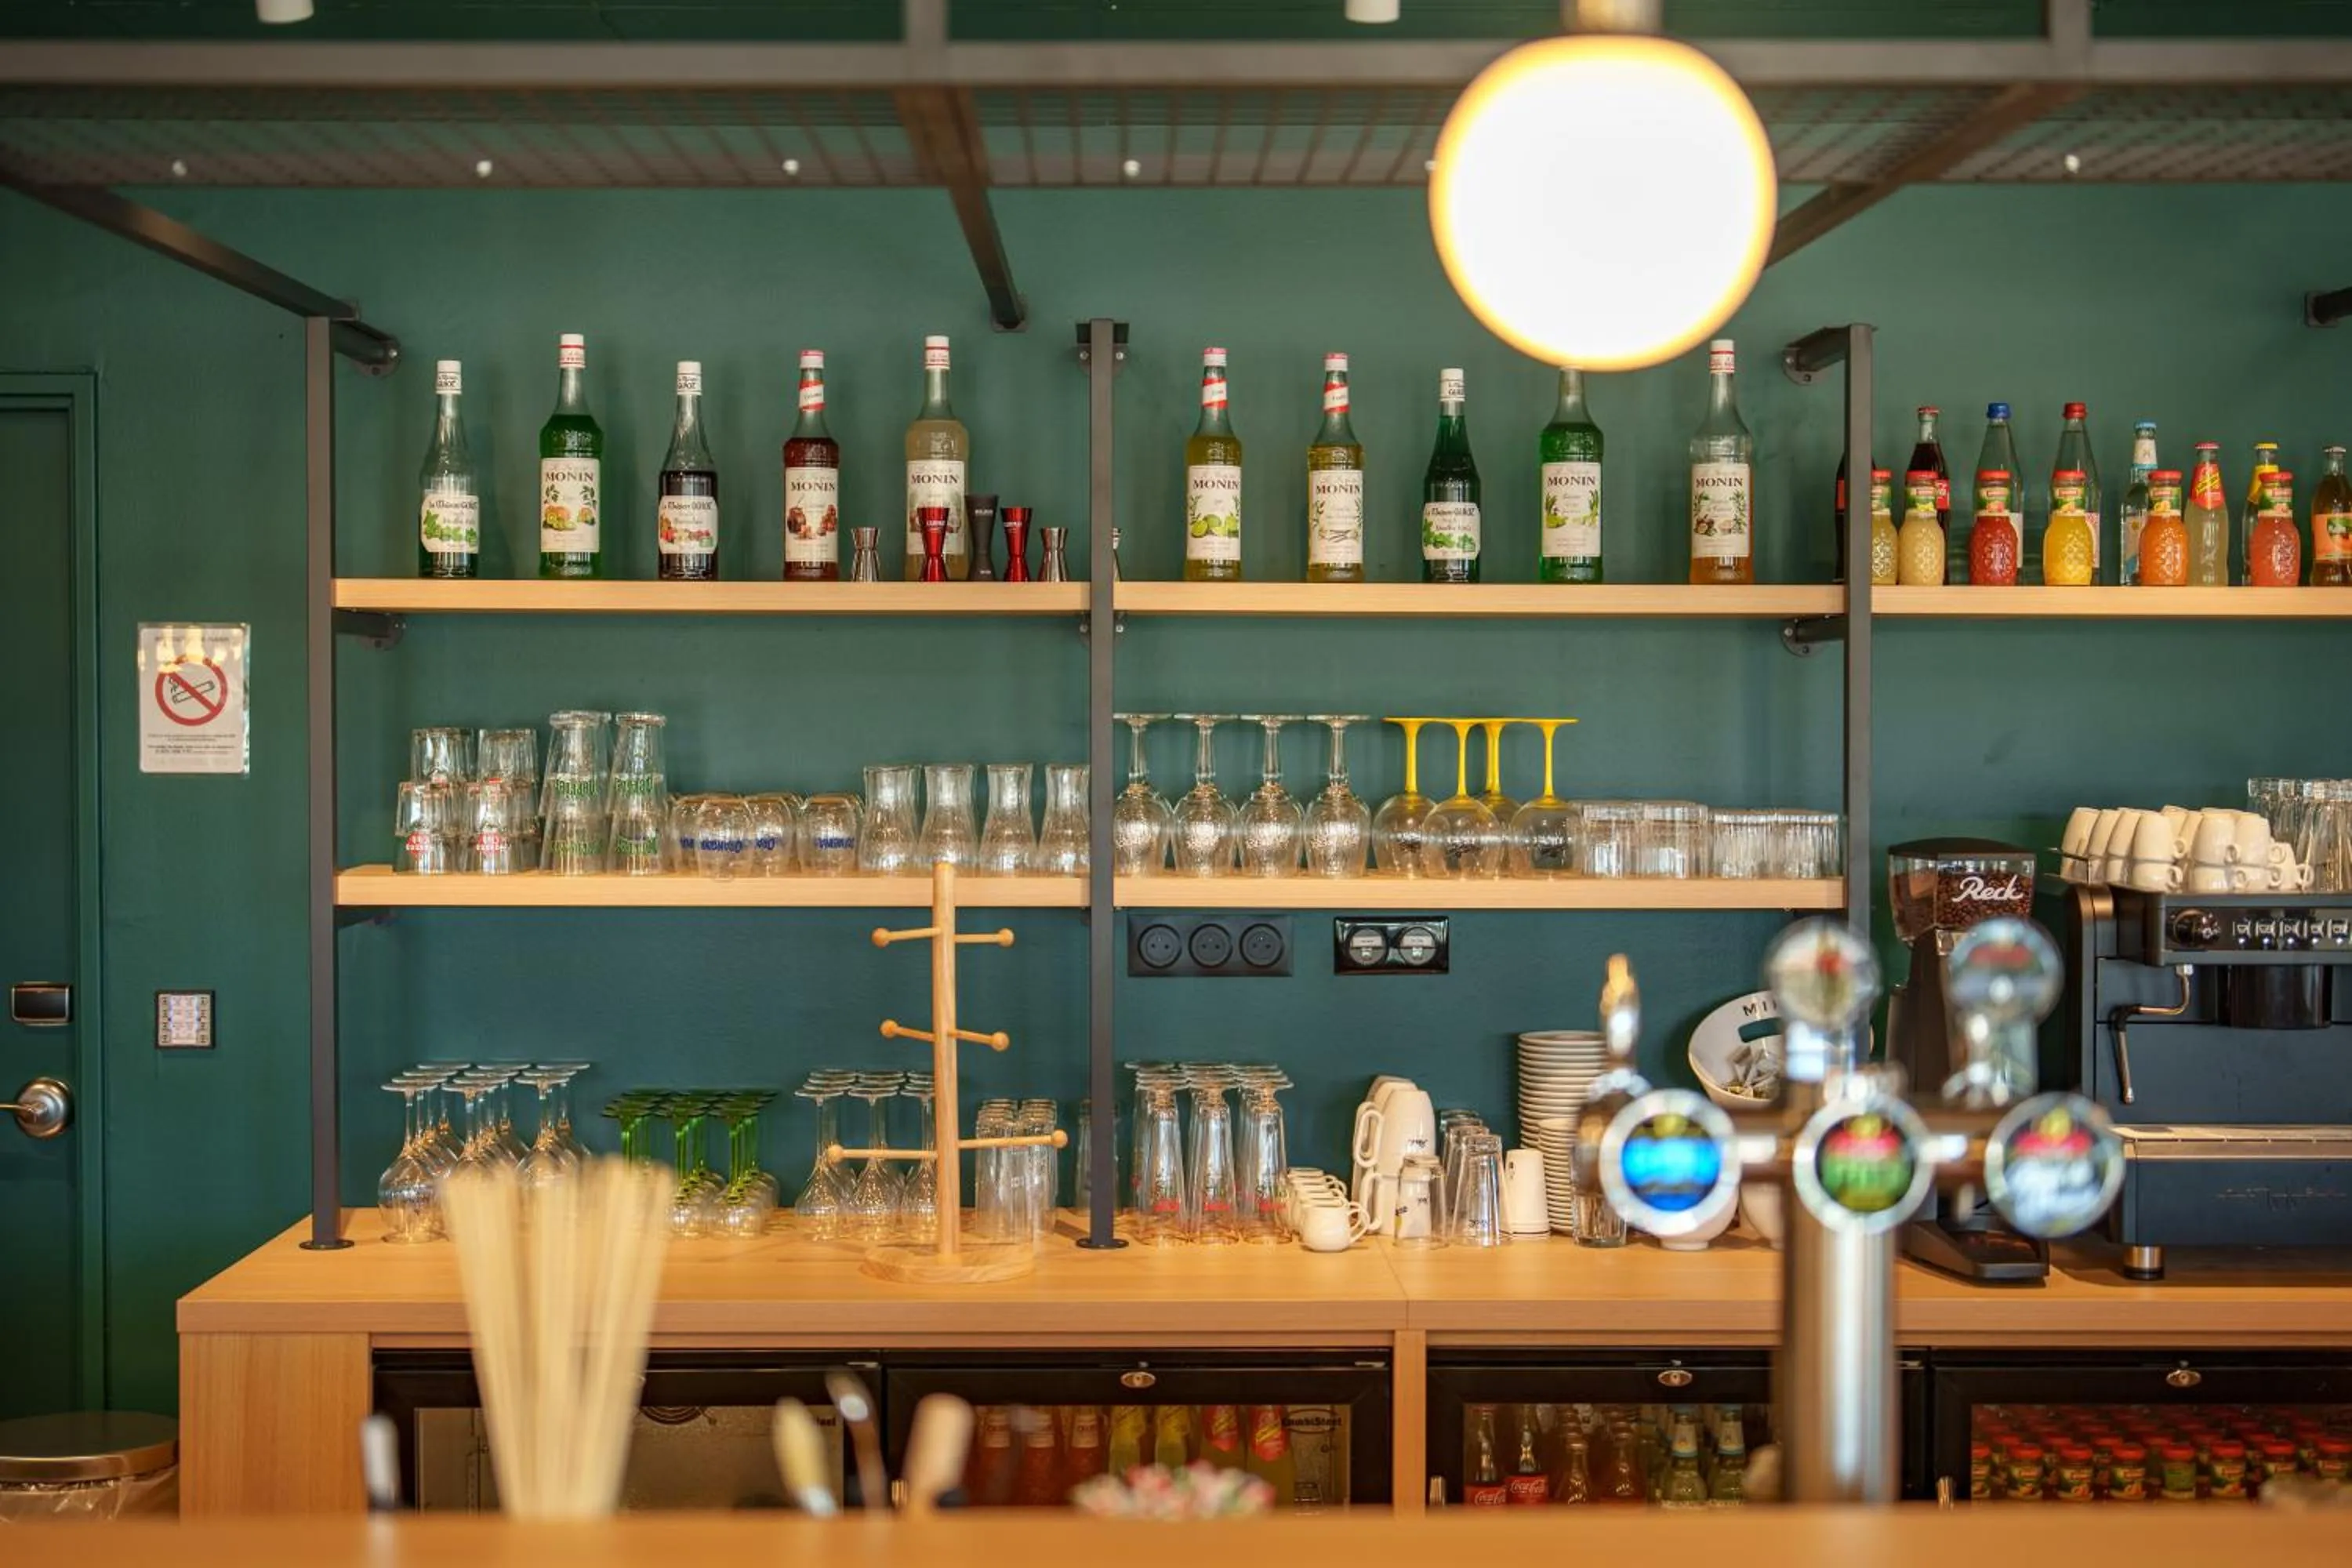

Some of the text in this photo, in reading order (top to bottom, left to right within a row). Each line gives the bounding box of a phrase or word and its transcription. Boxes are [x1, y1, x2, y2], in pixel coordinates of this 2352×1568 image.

[546, 471, 593, 481] MONIN
[911, 474, 958, 484] MONIN
[1548, 476, 1596, 486] MONIN
[791, 481, 835, 492] MONIN
[1193, 479, 1239, 489] MONIN
[1696, 477, 1744, 487] MONIN
[1316, 485, 1360, 494] MONIN
[1952, 873, 2024, 902] Reck
